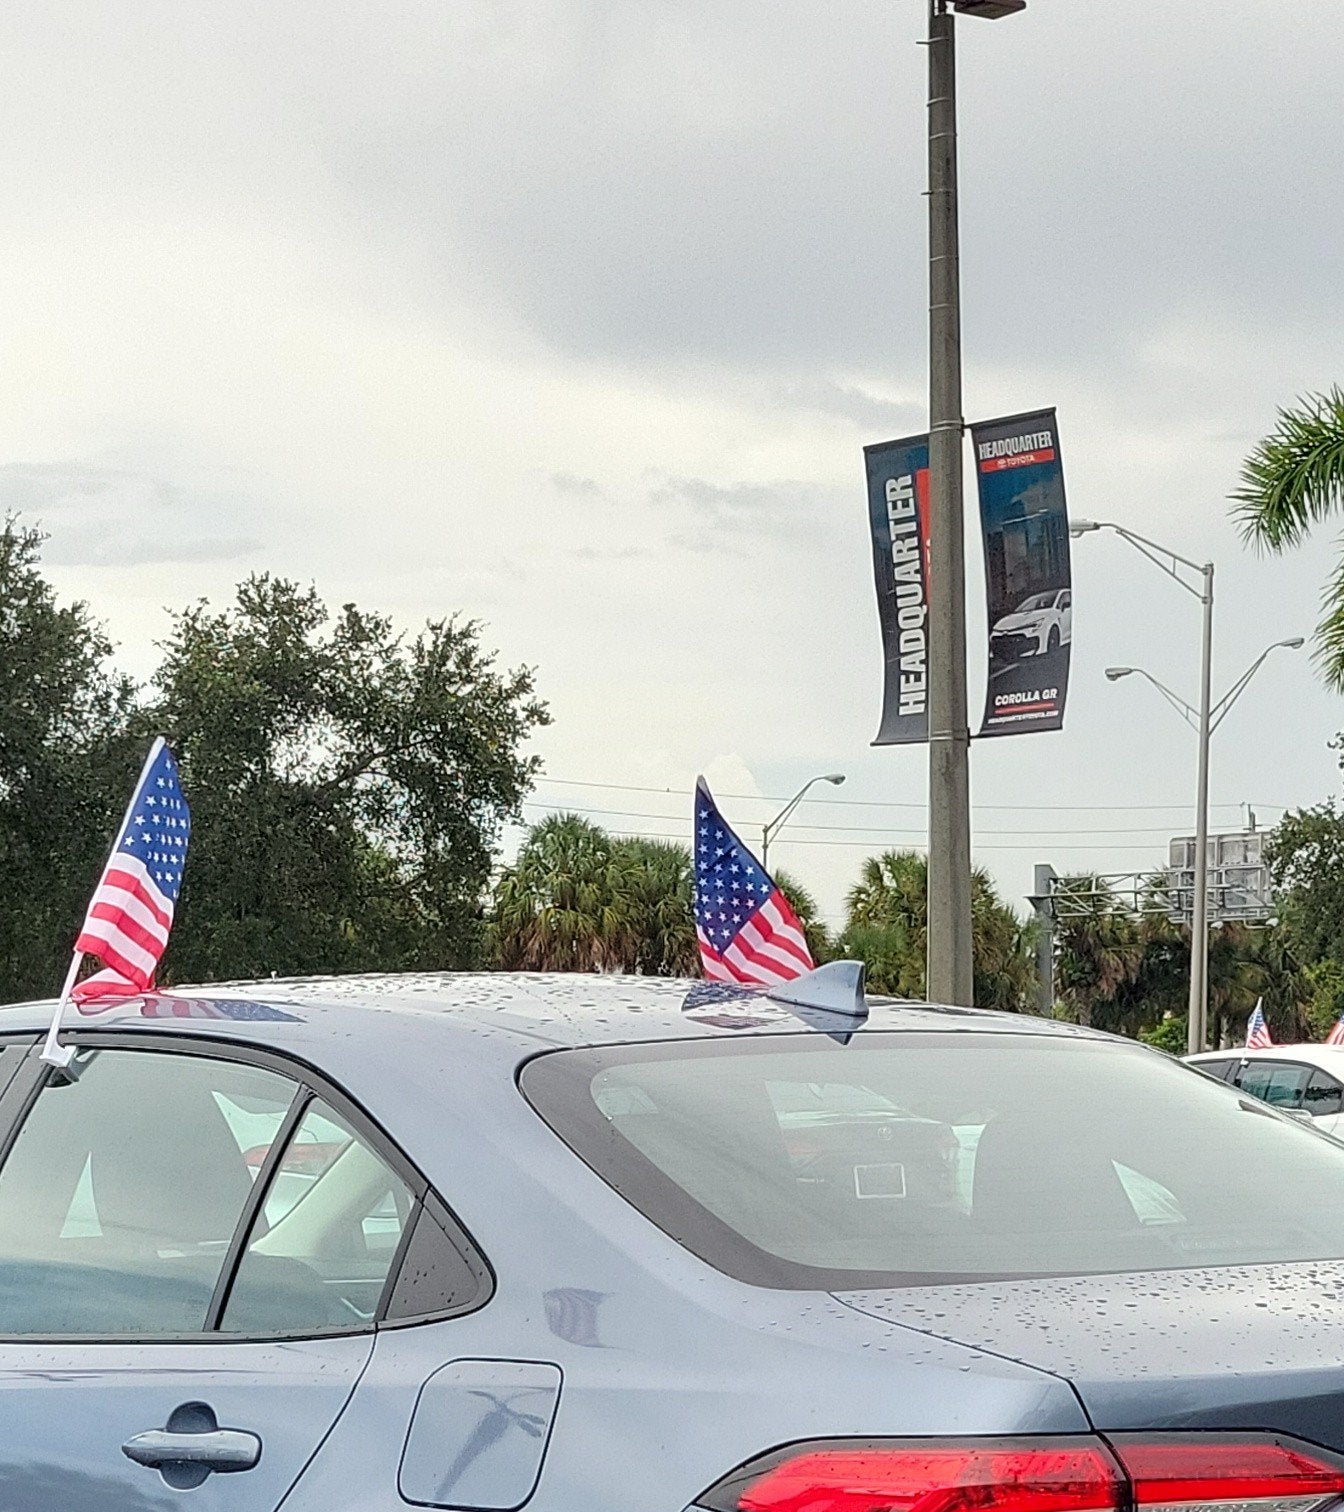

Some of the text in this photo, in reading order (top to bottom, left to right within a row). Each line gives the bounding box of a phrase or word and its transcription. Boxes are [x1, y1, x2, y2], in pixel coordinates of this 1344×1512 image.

[978, 430, 1053, 460] HEADQUARTER
[885, 474, 928, 716] HEADQUARTER
[994, 688, 1058, 706] COROLLA GR
